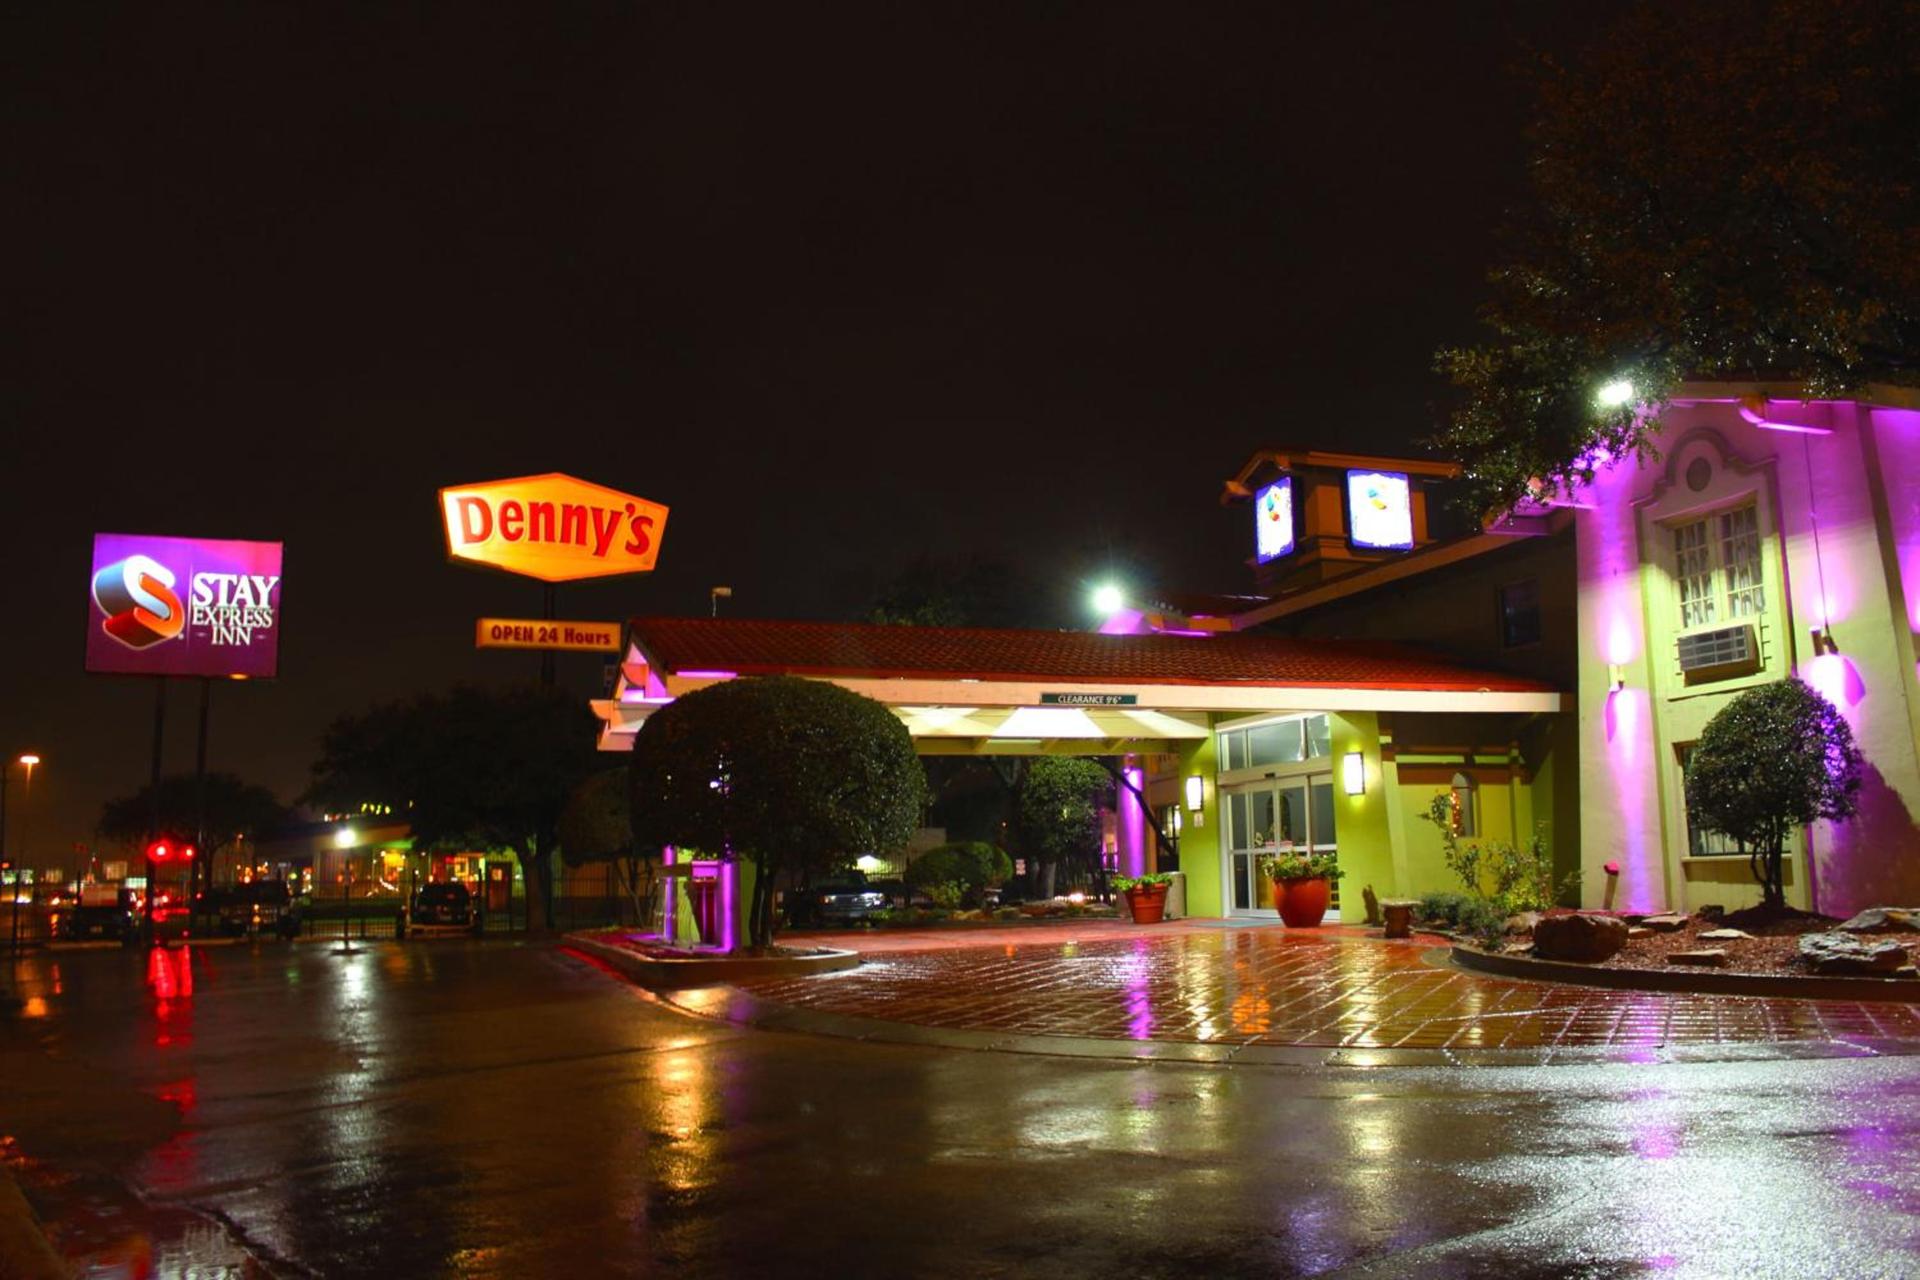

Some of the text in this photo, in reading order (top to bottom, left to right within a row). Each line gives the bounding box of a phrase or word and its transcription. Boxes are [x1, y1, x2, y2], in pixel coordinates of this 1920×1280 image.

[457, 497, 653, 557] Denny's
[192, 573, 279, 607] STAY
[192, 605, 274, 628] EXPRESS
[211, 626, 252, 646] INN
[491, 624, 611, 645] OPEN 24 Hours
[1058, 695, 1104, 704] CLEARANCE
